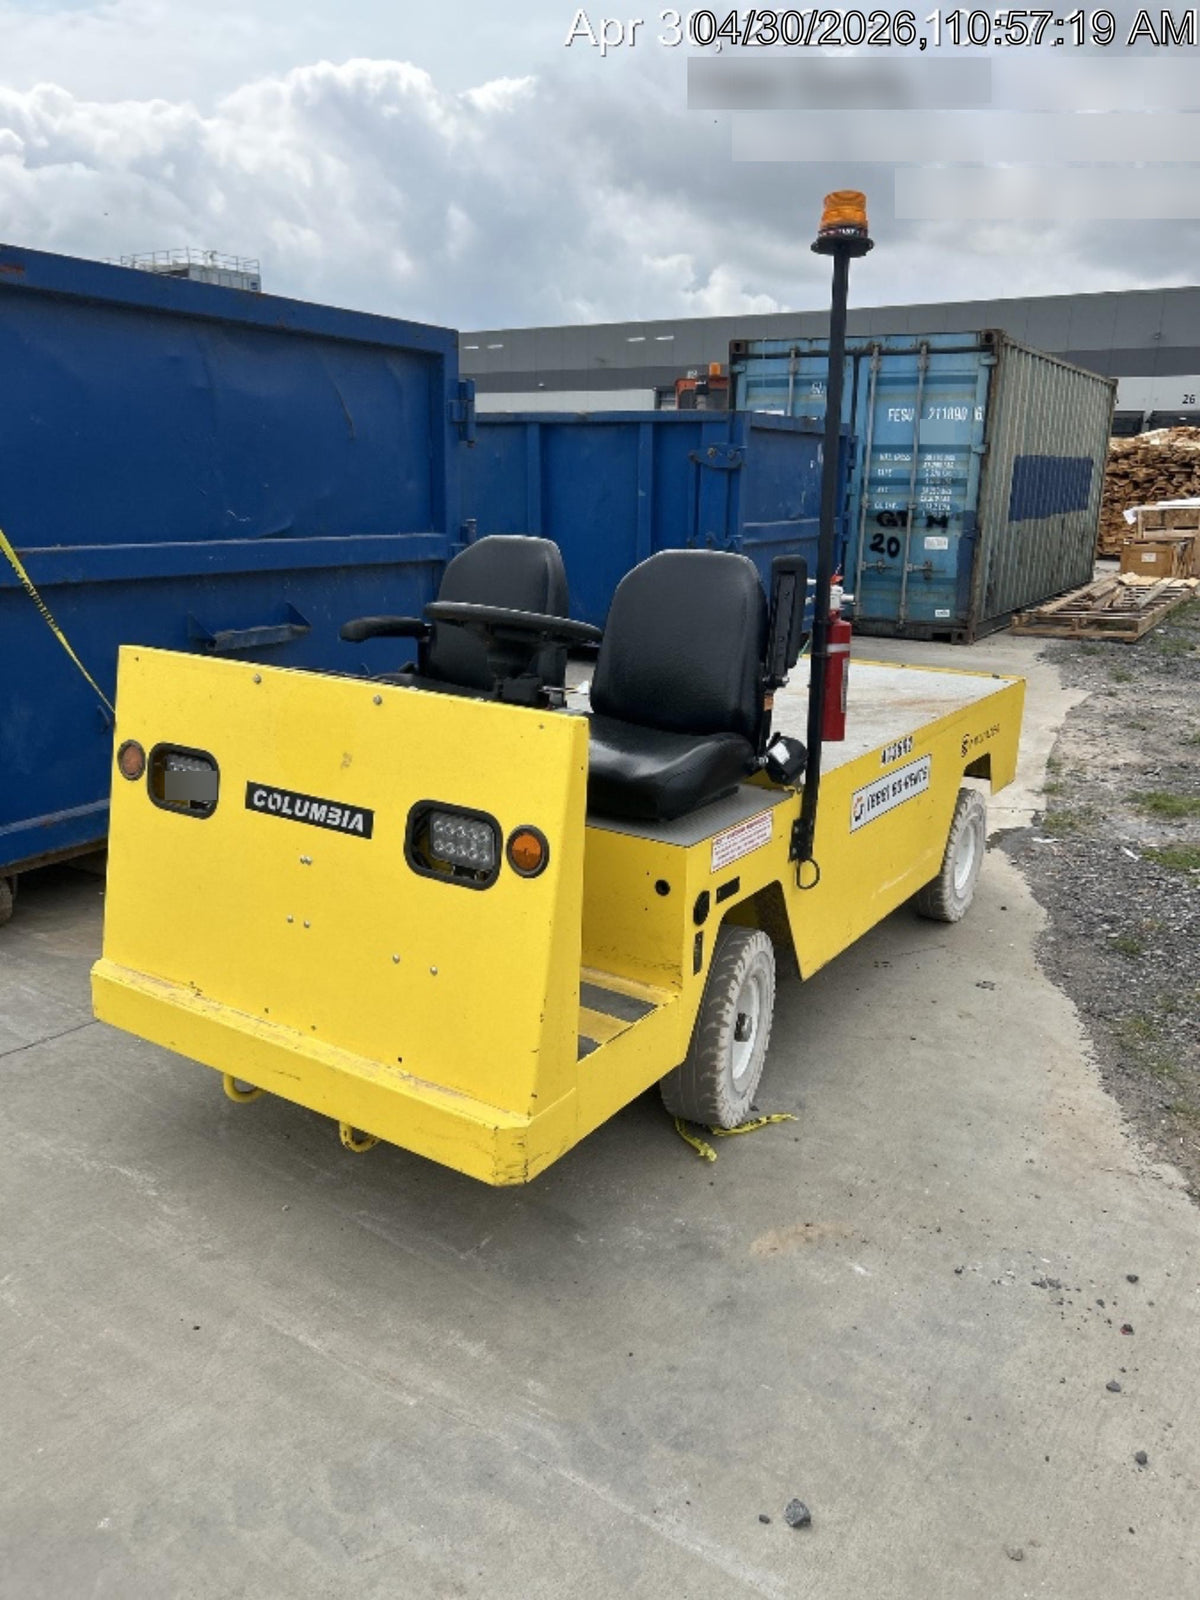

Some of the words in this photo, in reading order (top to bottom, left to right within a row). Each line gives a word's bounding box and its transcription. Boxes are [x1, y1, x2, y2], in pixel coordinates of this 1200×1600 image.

[1182, 393, 1197, 405] 26
[869, 532, 900, 558] 20
[253, 789, 364, 832] COLUMBIA
